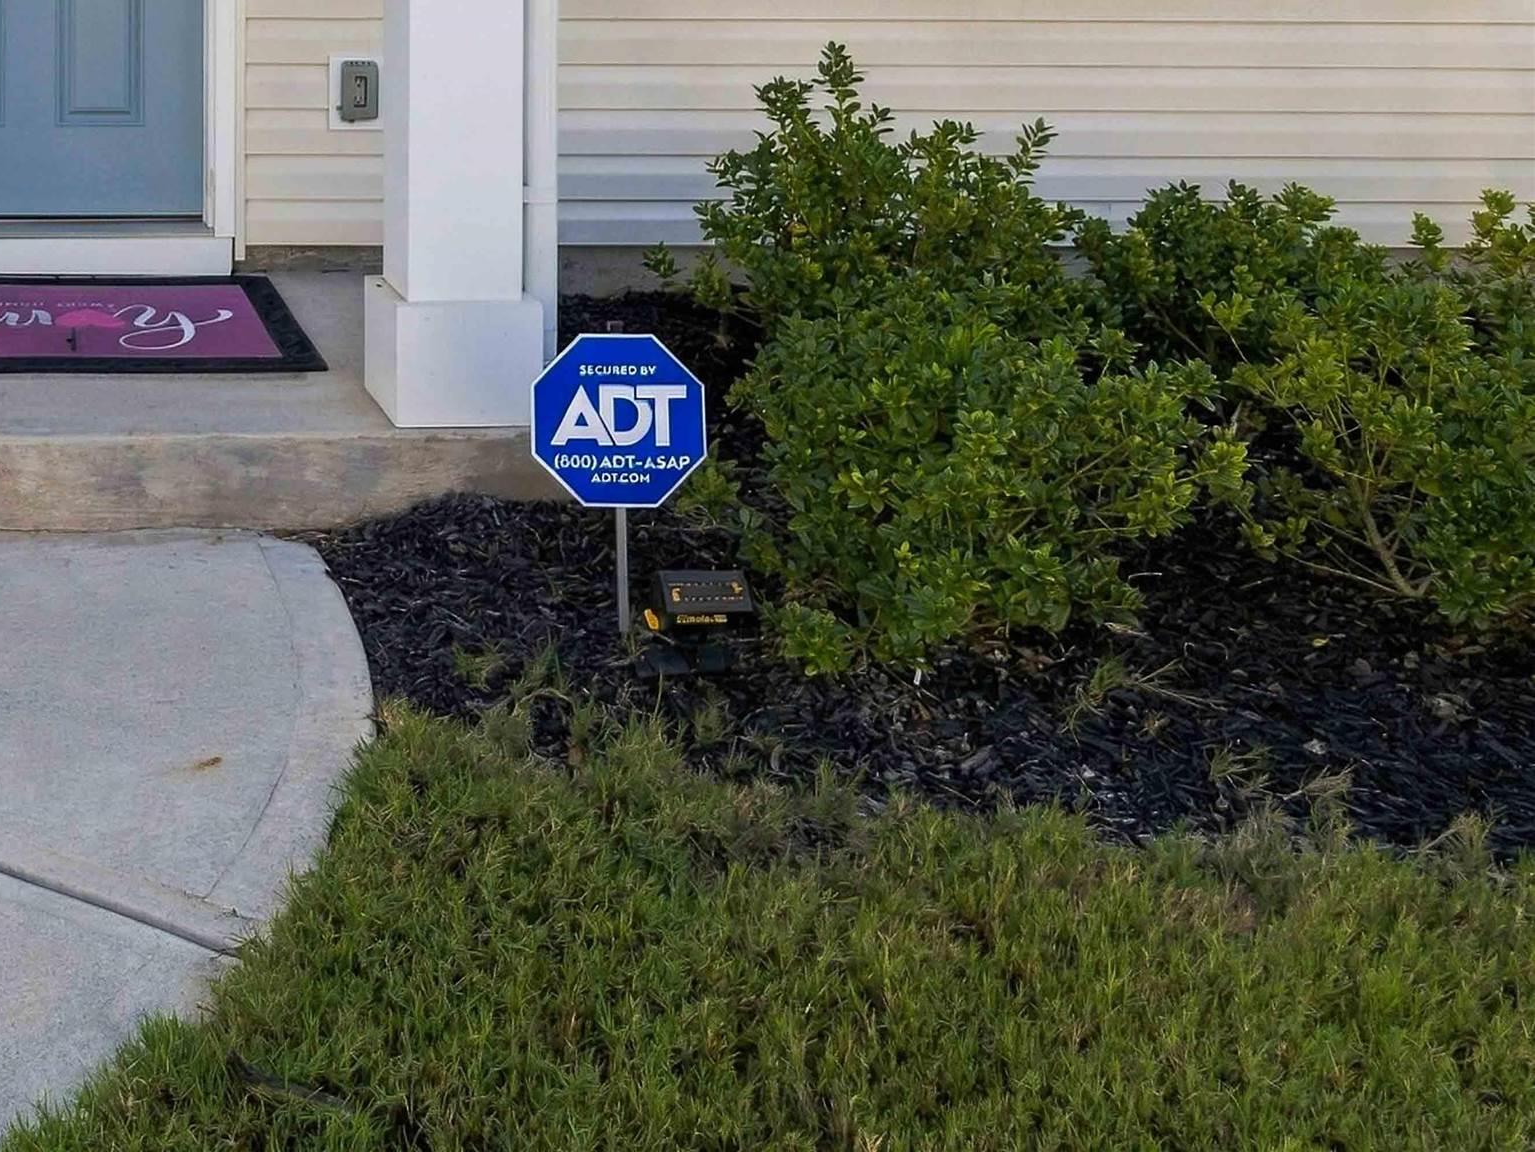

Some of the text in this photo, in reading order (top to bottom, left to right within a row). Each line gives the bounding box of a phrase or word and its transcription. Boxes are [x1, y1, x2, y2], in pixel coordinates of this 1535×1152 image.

[579, 365, 657, 376] SECURED BY
[550, 384, 687, 446] ADT
[554, 453, 690, 470] (800) ADT-ASAP
[591, 473, 650, 483] ADT.COM
